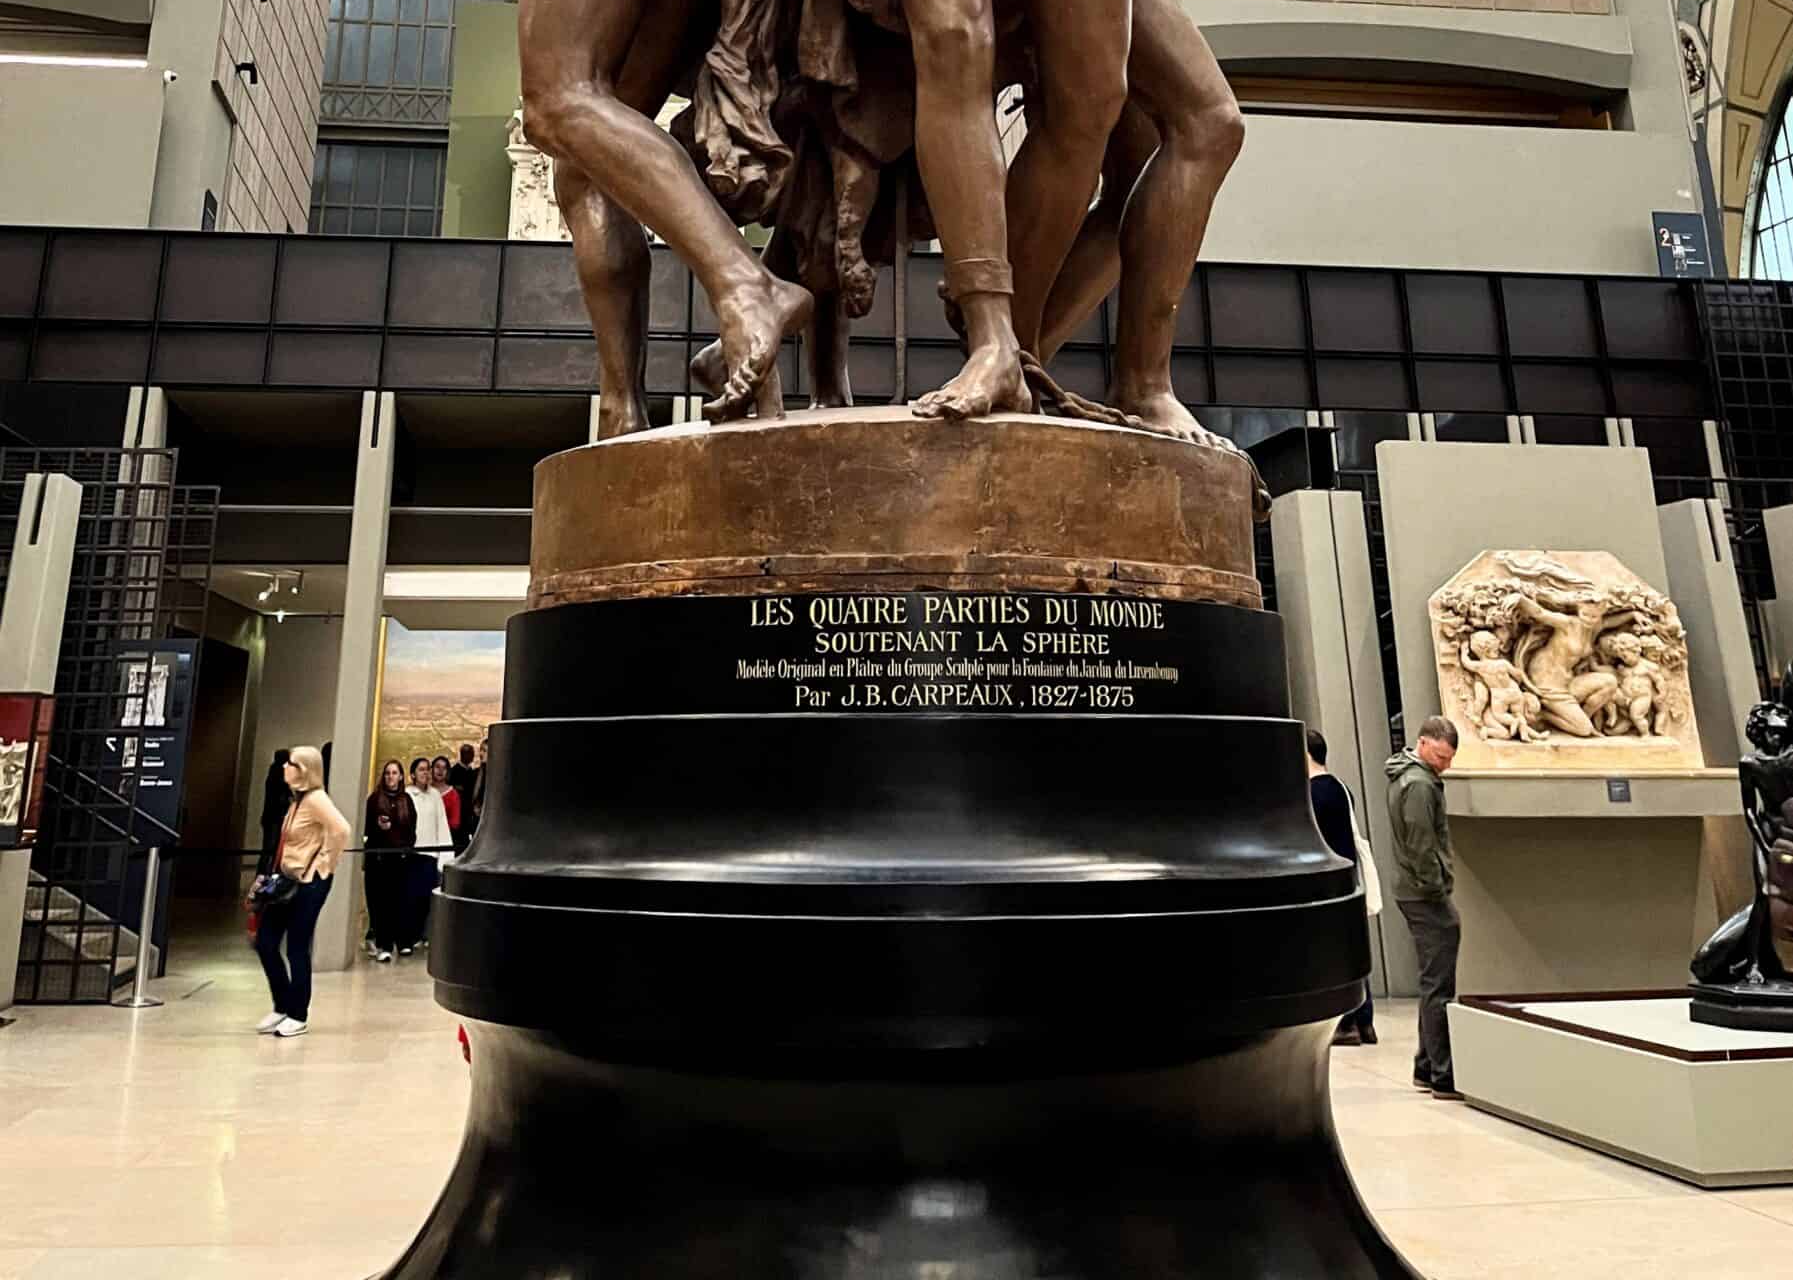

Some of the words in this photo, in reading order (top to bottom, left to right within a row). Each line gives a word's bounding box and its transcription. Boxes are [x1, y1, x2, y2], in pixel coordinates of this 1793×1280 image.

[1659, 227, 1673, 247] 2
[750, 598, 795, 626] LES
[808, 596, 909, 629] QUATRE
[924, 596, 1030, 624] PARTIES
[1044, 598, 1079, 626] DU
[1089, 600, 1165, 629] MONDE
[814, 631, 963, 653] SOUTENANT
[976, 631, 1008, 652] LA
[1021, 627, 1110, 655] SPHÈRE
[735, 658, 776, 680] Modèle
[777, 658, 826, 682] Original
[829, 663, 844, 679] en
[887, 660, 902, 678] du
[904, 657, 944, 681] Groupe
[945, 657, 984, 681] Sculpté
[986, 662, 1009, 681] pour
[1012, 658, 1022, 677] la
[1022, 658, 1065, 678] Fontaine
[1066, 659, 1079, 679] du
[1079, 659, 1112, 680] Jardin
[1114, 661, 1128, 680] du
[794, 685, 831, 707] Par
[1031, 684, 1134, 707] 1827-1875
